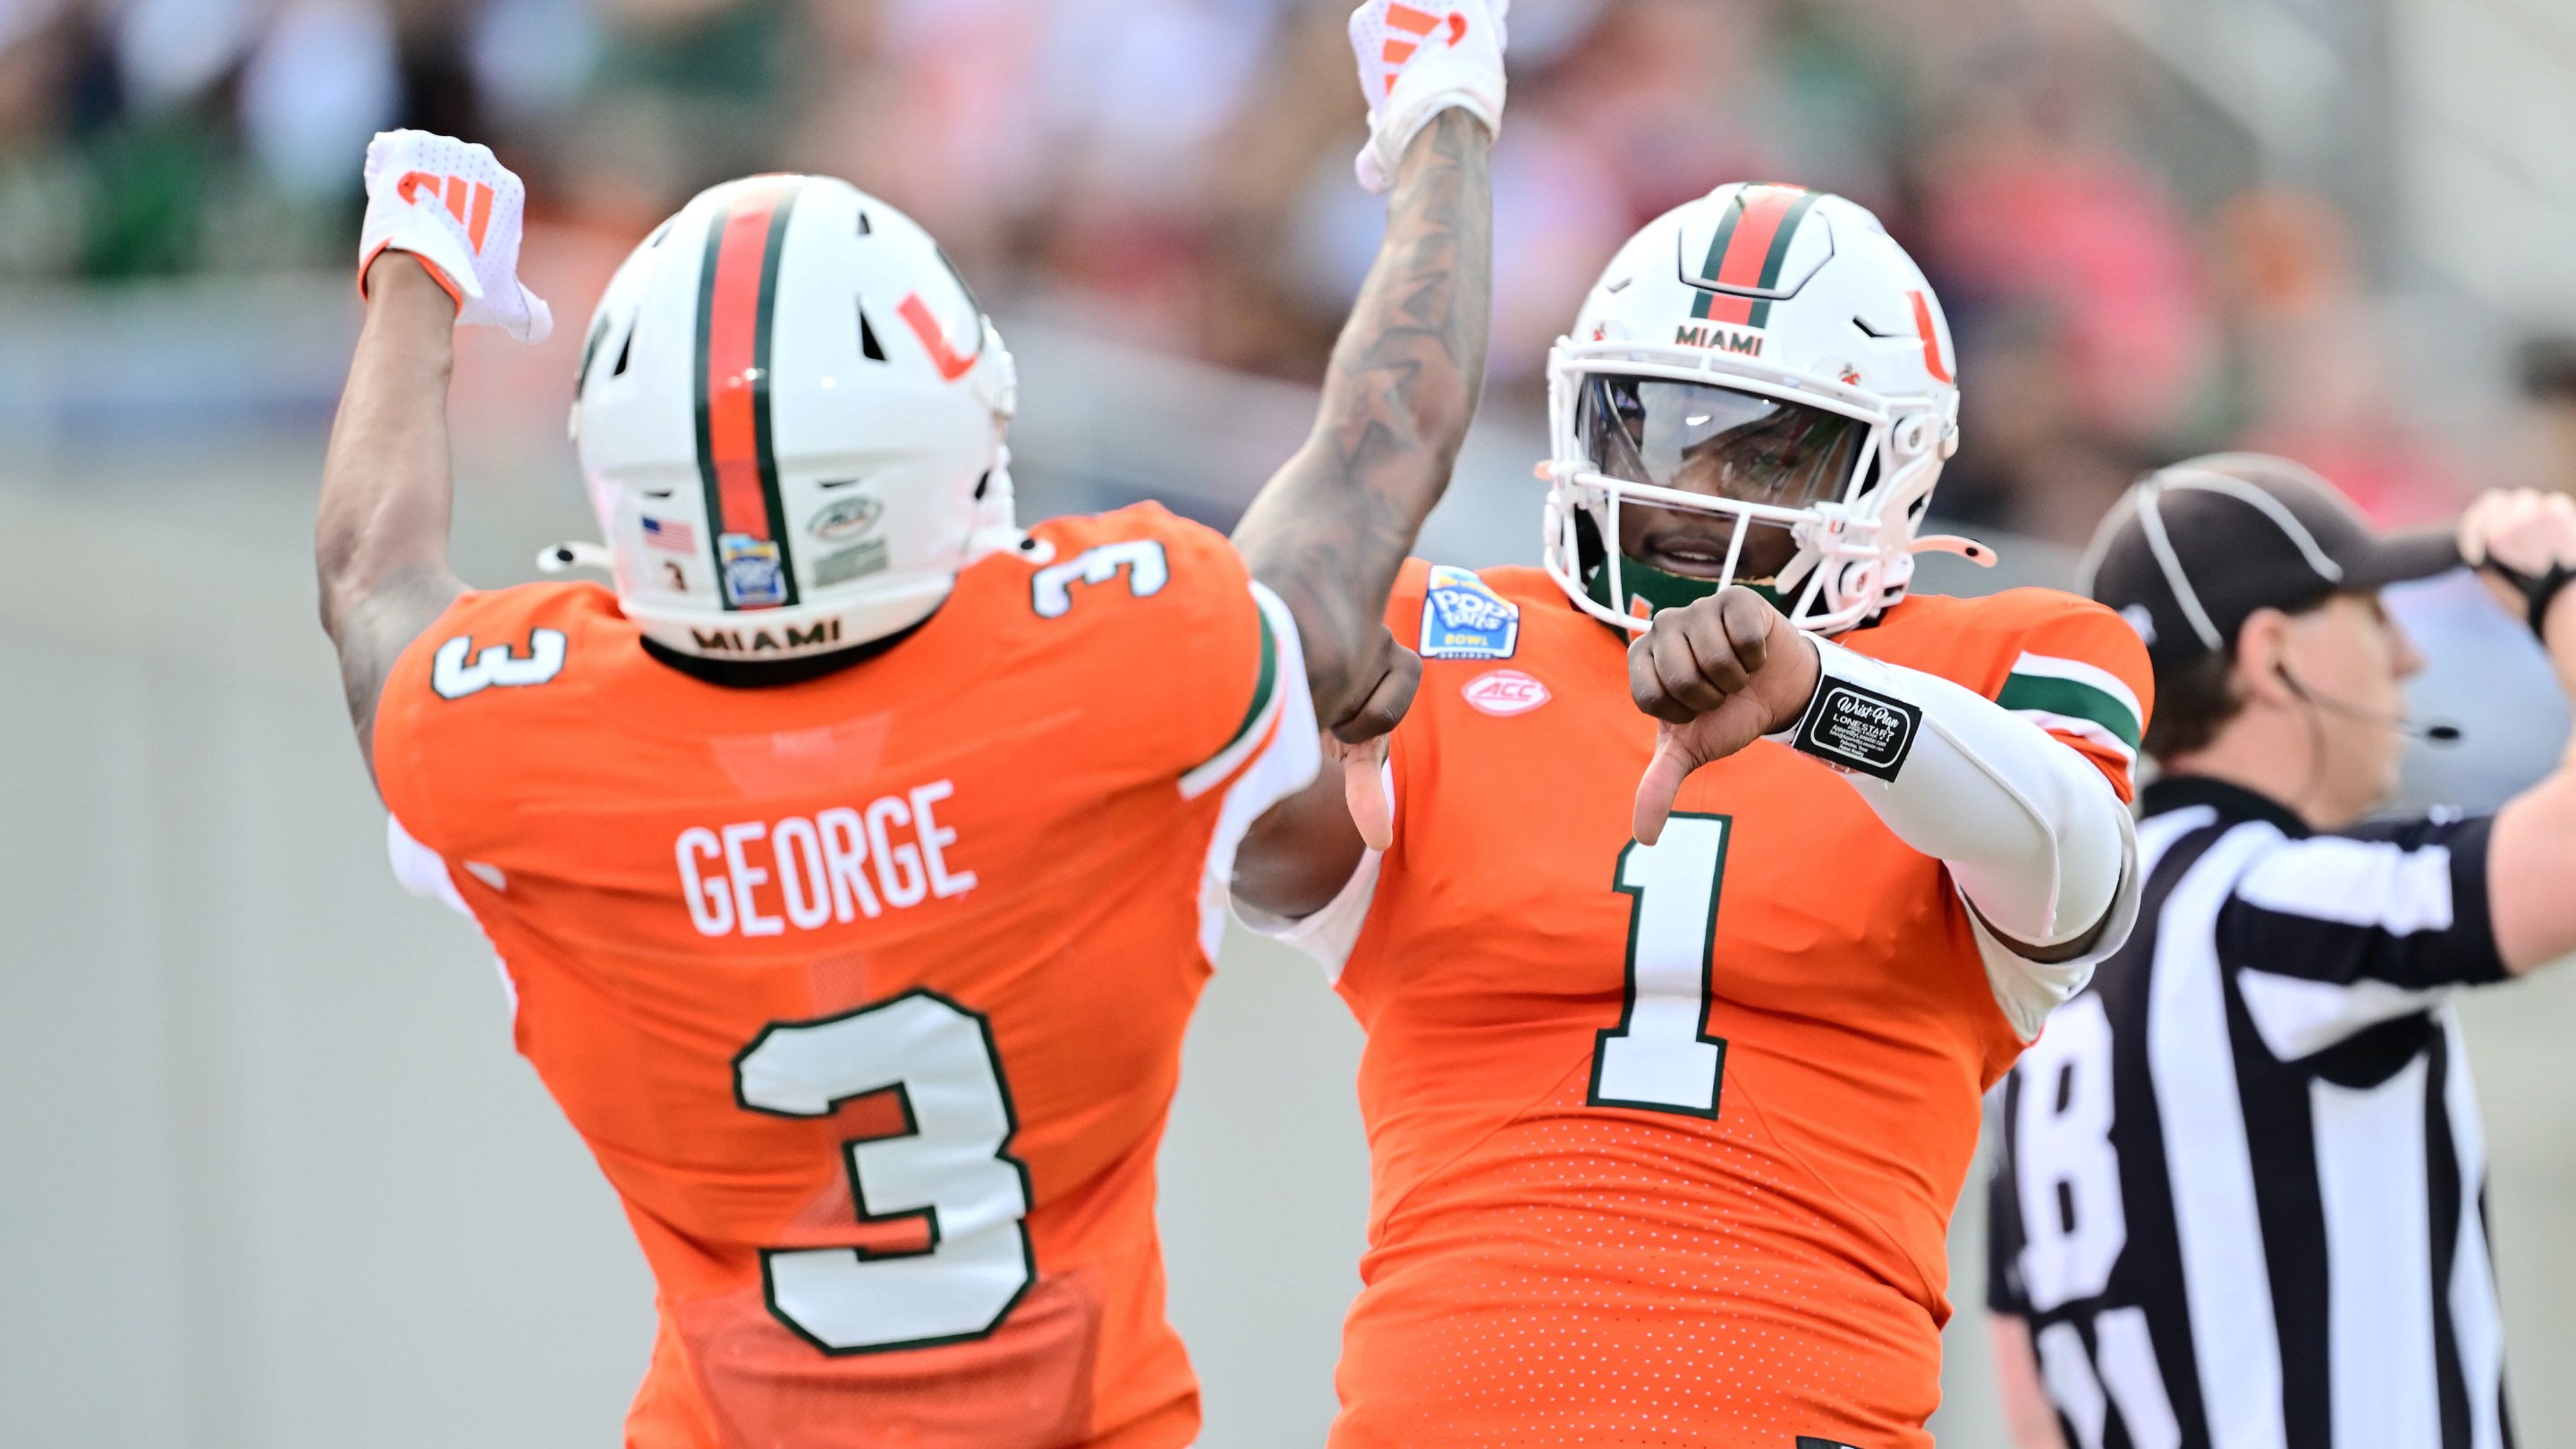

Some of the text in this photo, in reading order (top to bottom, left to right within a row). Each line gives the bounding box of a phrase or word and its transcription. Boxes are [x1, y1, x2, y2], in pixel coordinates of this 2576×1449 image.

[1675, 325, 1764, 358] MIAMI
[1030, 538, 1171, 619] 3
[430, 626, 567, 701] 3
[691, 618, 841, 651] MIAMI
[1445, 633, 1489, 647] BOWL
[1475, 682, 1538, 699] ACC
[674, 778, 978, 937] GEORGE
[1586, 809, 1733, 1120] 1
[732, 987, 1038, 1357] 3
[2012, 988, 2127, 1314] B
